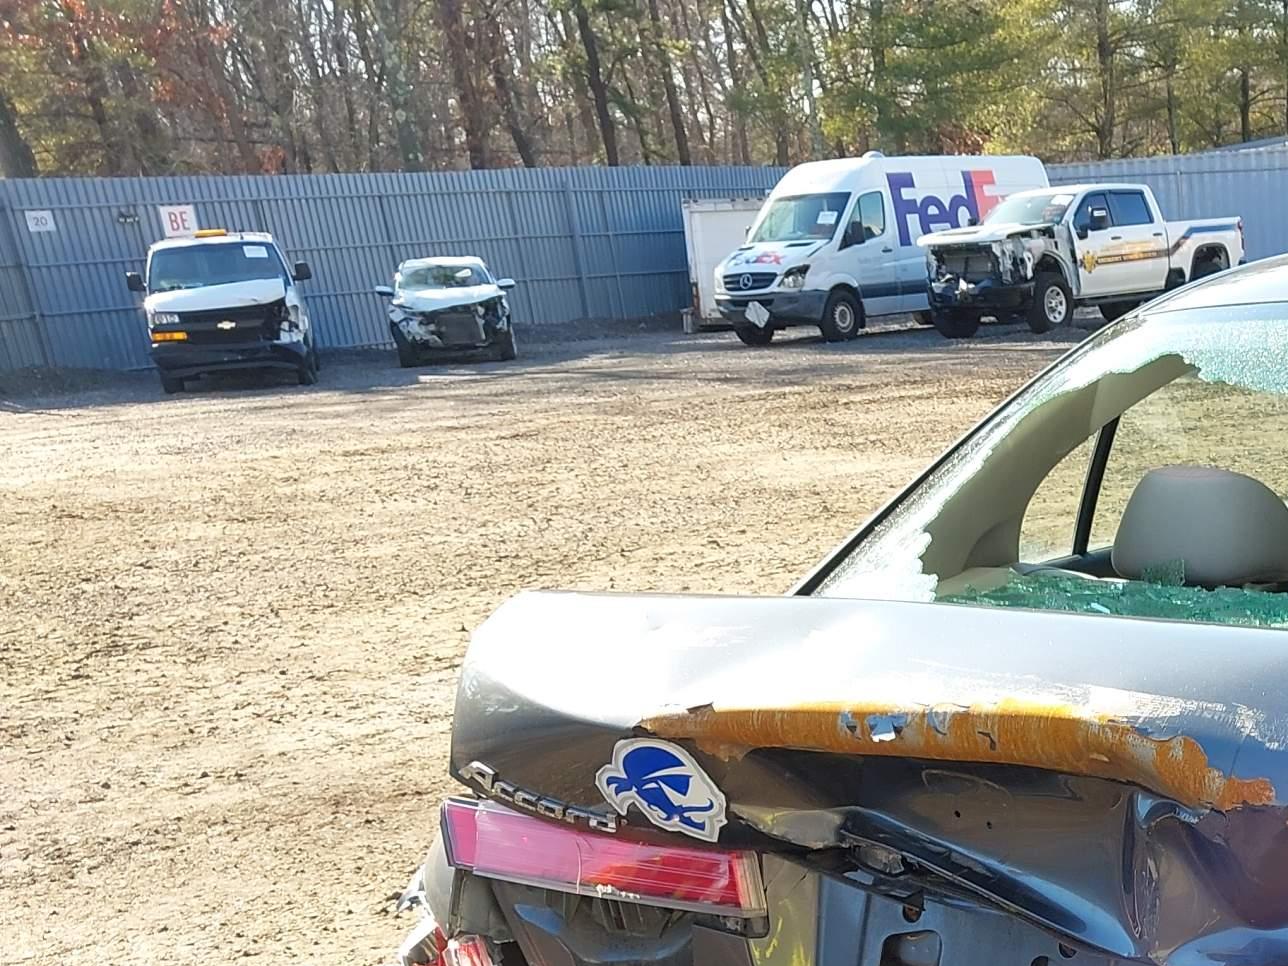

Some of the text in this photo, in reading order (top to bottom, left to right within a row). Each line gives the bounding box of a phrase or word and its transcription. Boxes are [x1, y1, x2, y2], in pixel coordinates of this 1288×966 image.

[32, 216, 48, 227] 20
[168, 211, 191, 232] BE
[886, 169, 1002, 247] FedE
[458, 760, 617, 833] Accord
